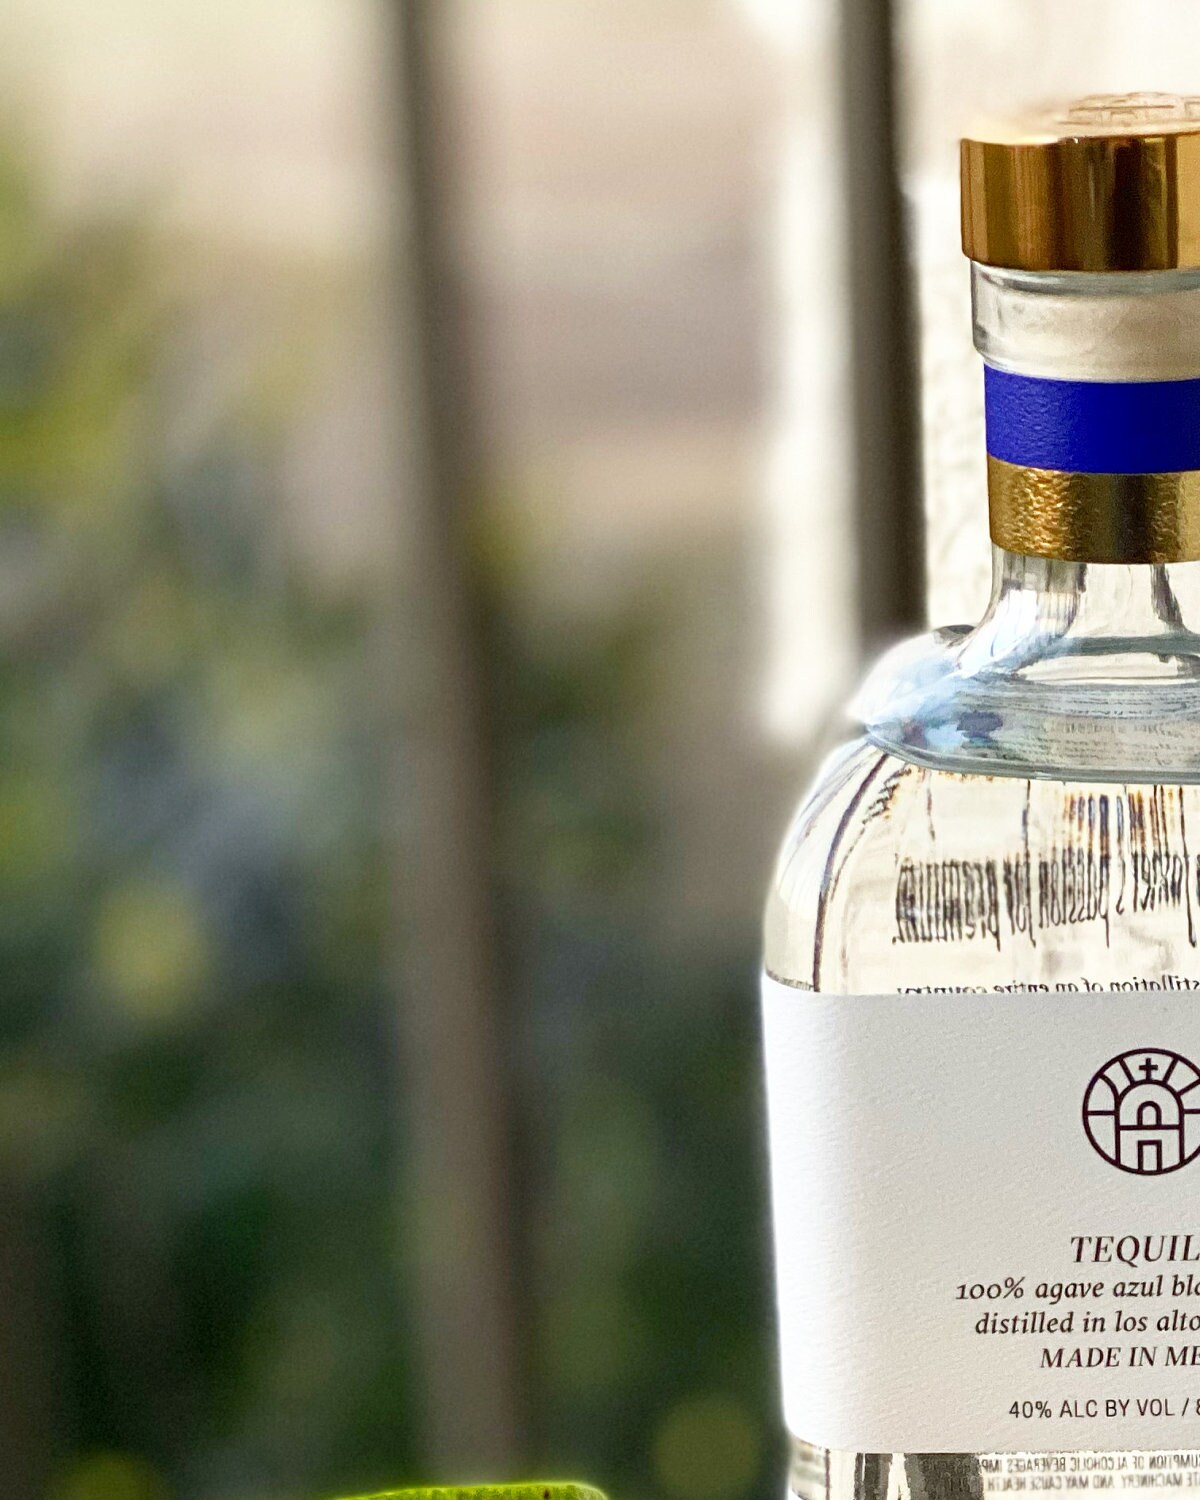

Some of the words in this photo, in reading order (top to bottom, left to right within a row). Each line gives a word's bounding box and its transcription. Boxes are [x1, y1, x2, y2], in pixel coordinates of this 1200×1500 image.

[955, 1276, 1025, 1301] 100%
[1034, 1280, 1105, 1305] agave
[1112, 1275, 1163, 1298] azul
[974, 1311, 1074, 1335] distilled
[1083, 1311, 1106, 1332] in
[1114, 1310, 1148, 1332] los
[1040, 1346, 1121, 1369] MADE
[1128, 1346, 1156, 1367] IN
[1008, 1399, 1052, 1419] 40%
[1059, 1399, 1098, 1418] ALC
[1105, 1398, 1130, 1417] BY
[1136, 1398, 1176, 1417] VOL
[1181, 1397, 1189, 1417] /
